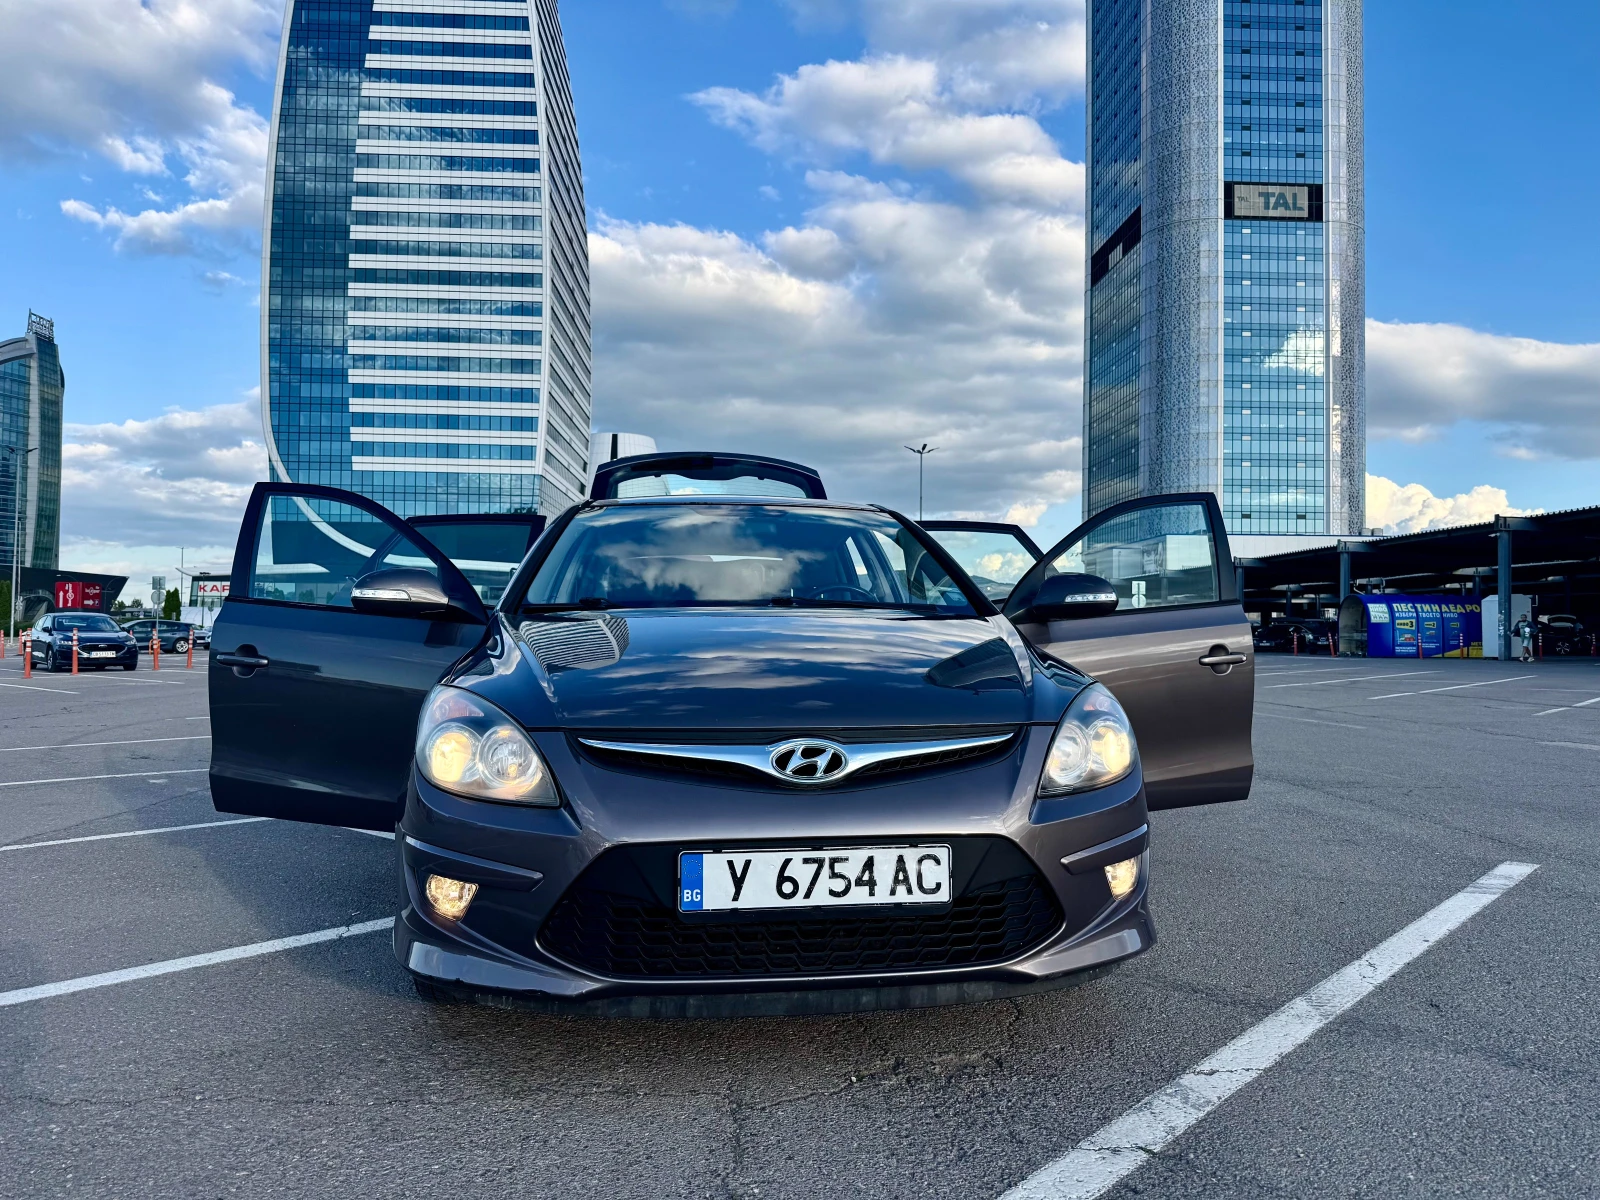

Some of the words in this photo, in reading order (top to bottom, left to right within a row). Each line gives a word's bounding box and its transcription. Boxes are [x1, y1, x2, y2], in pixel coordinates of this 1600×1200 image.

[1258, 192, 1305, 212] TAL
[726, 858, 752, 902] Y
[775, 855, 878, 900] 6754
[889, 853, 942, 897] AC
[683, 889, 701, 902] BG
